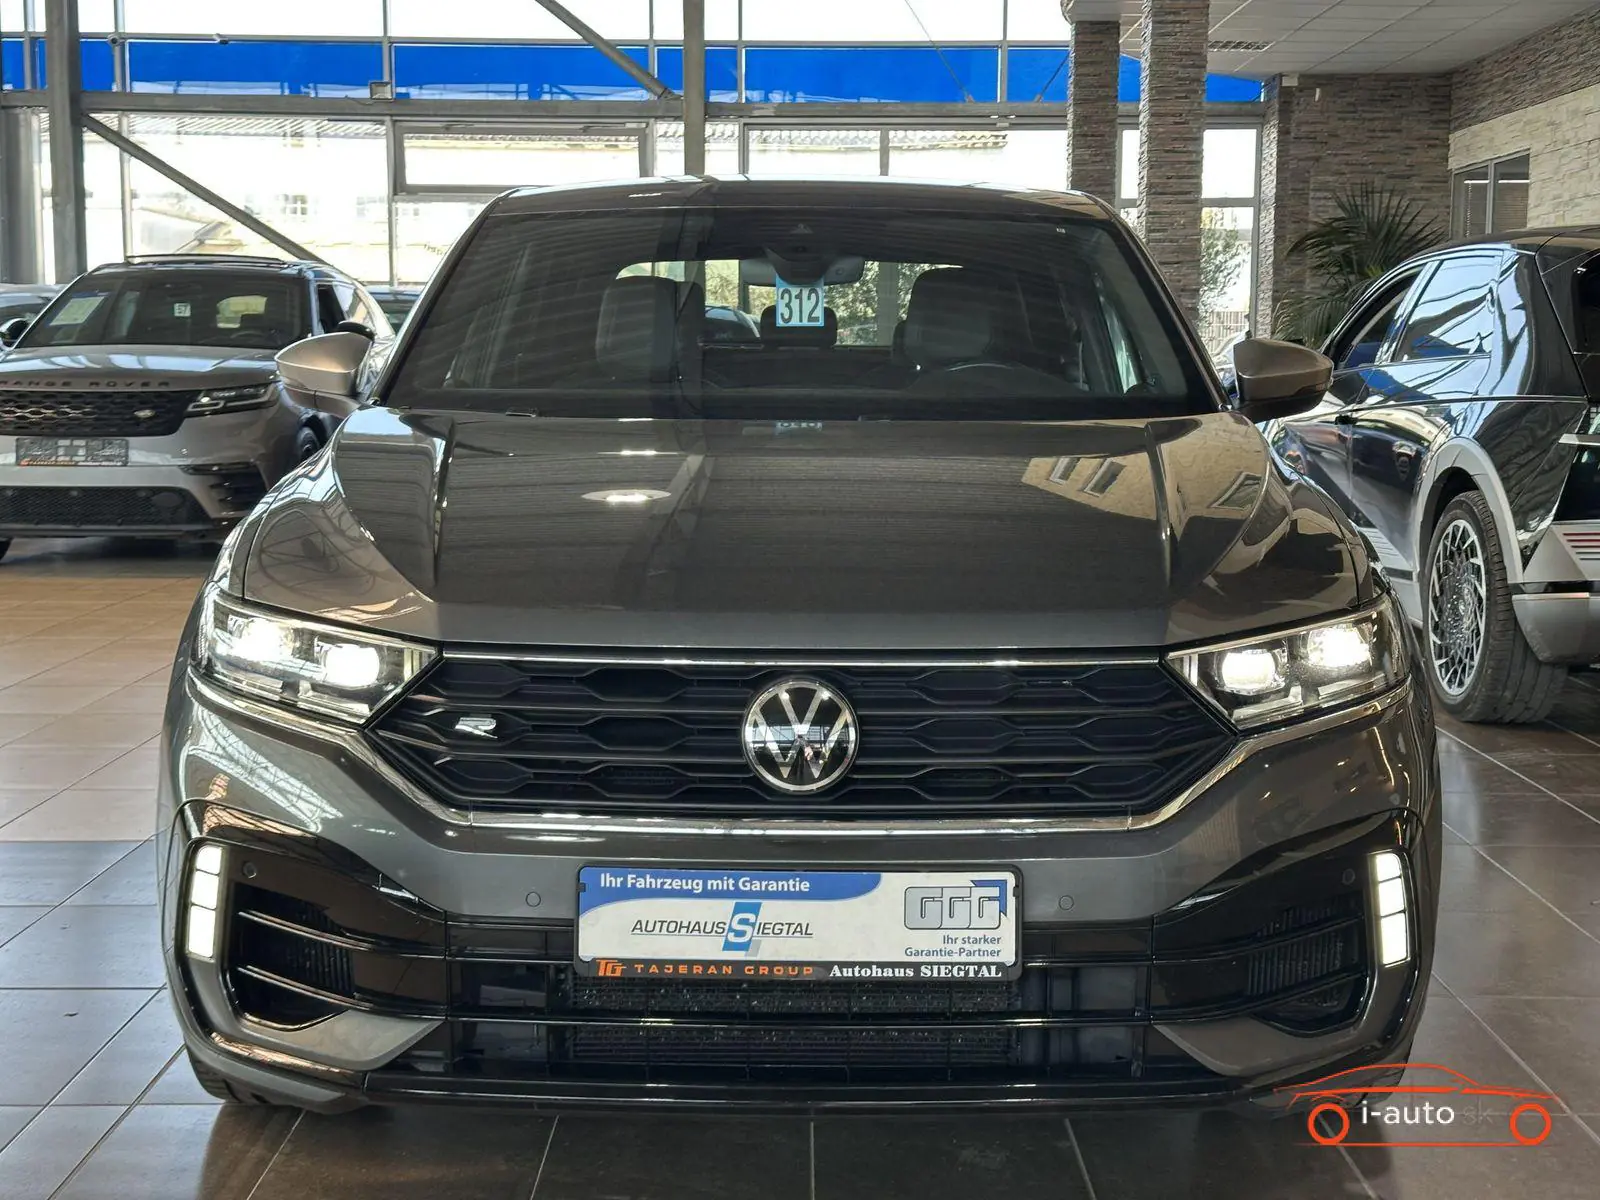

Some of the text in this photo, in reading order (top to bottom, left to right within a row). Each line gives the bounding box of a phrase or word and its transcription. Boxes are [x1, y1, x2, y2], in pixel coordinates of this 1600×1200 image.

[780, 287, 820, 323] 312
[746, 681, 856, 791] VW
[600, 873, 810, 892] Ihr Fahrzeug mit Garantie
[631, 913, 814, 943] AUTOHAUS SIEGTAL
[943, 934, 1001, 945] Ihr starker
[904, 947, 1001, 958] Garantie-Partner
[634, 964, 813, 975] TAJERAN GROUP
[829, 965, 1001, 977] Autohaus SIEGTAL
